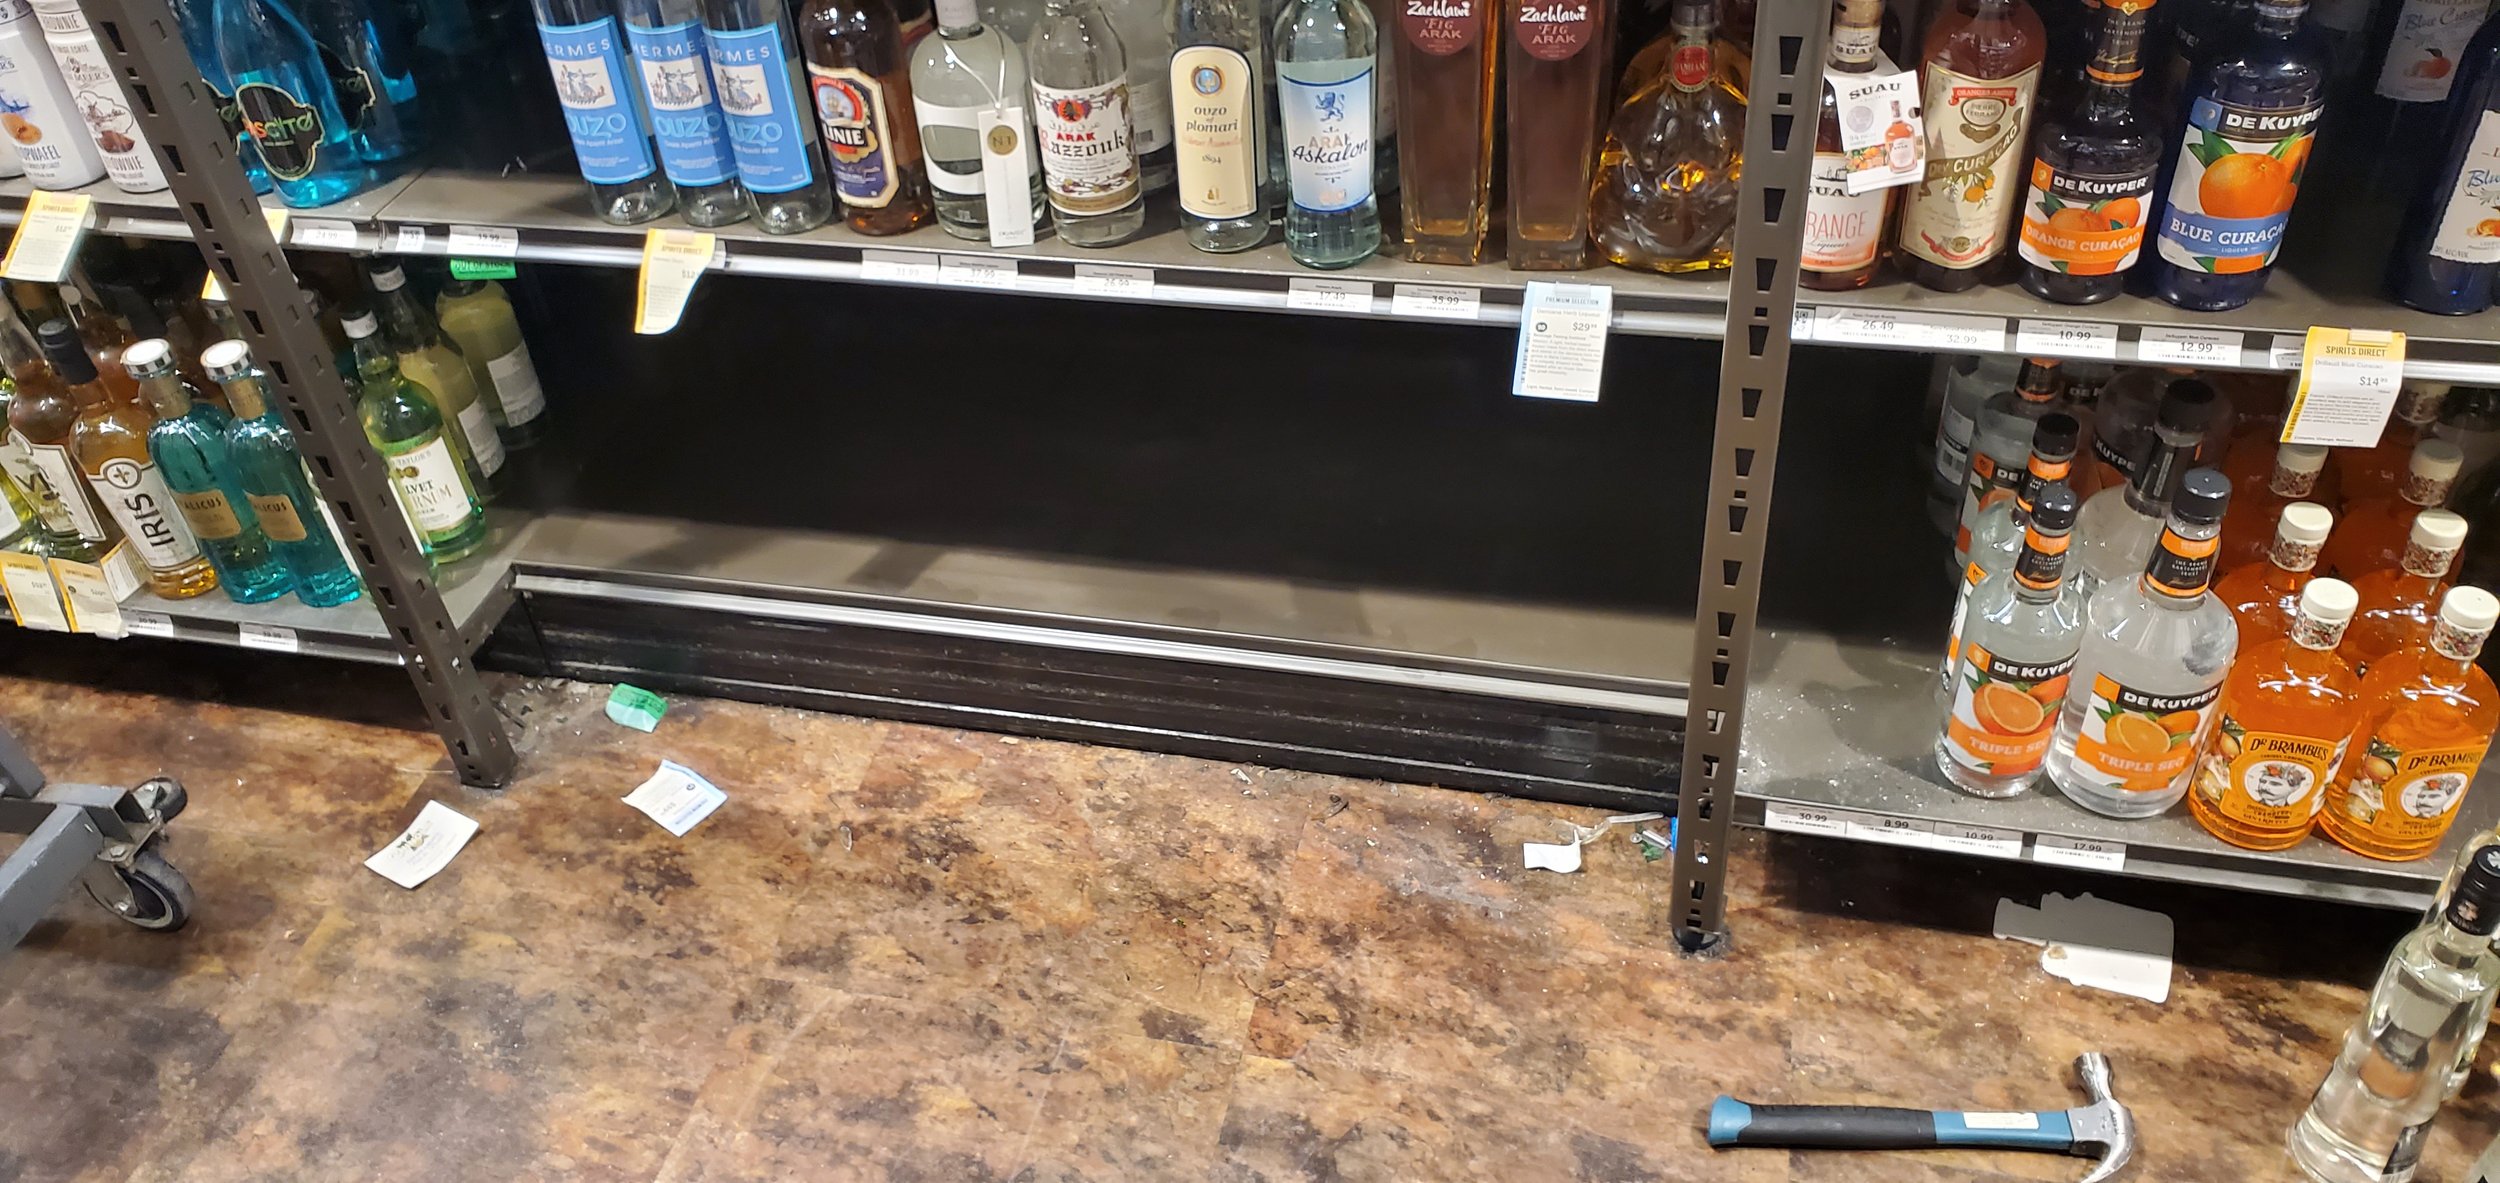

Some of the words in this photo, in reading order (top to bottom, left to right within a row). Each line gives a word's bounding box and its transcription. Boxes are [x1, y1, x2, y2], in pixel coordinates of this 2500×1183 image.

[1520, 3, 1587, 23] Zachlawi
[1425, 19, 1453, 29] FIG
[1538, 24, 1568, 34] FIG
[1419, 28, 1462, 39] ARAK
[1531, 34, 1576, 44] ARAK
[545, 38, 610, 57] ERMES
[1849, 82, 1902, 100] SUAU
[655, 111, 722, 139] OUZO
[1186, 118, 1238, 133] plomari
[2226, 113, 2257, 130] DE
[1056, 132, 1097, 143] ARAK
[1292, 138, 1368, 164] Askalon
[2053, 175, 2076, 190] DE
[2078, 177, 2146, 194] KUYPER
[2170, 217, 2213, 243] BLUE
[2025, 225, 2077, 250] ORANGE
[2079, 231, 2140, 252] CURAÇAO
[1432, 295, 1459, 306] 35.99
[1862, 320, 1894, 331] 26.49
[2059, 330, 2091, 341] 10.99
[2180, 342, 2213, 353] 12.99
[2325, 346, 2357, 356] SPIRITS
[2358, 348, 2386, 357] DIRECT
[1997, 469, 2018, 482] DE
[125, 493, 175, 548] IRIS
[1994, 661, 2018, 676] DE
[2123, 691, 2149, 706] DE
[2152, 688, 2218, 709] KUYPER
[1969, 736, 2022, 754] TRIPLE
[2098, 751, 2153, 772] TRIPLE
[2158, 757, 2185, 772] SEC
[1800, 812, 1827, 822] 30.99
[1884, 819, 1909, 829] 8.99
[1965, 831, 1994, 841] 10.99
[2073, 842, 2102, 852] 17.99
